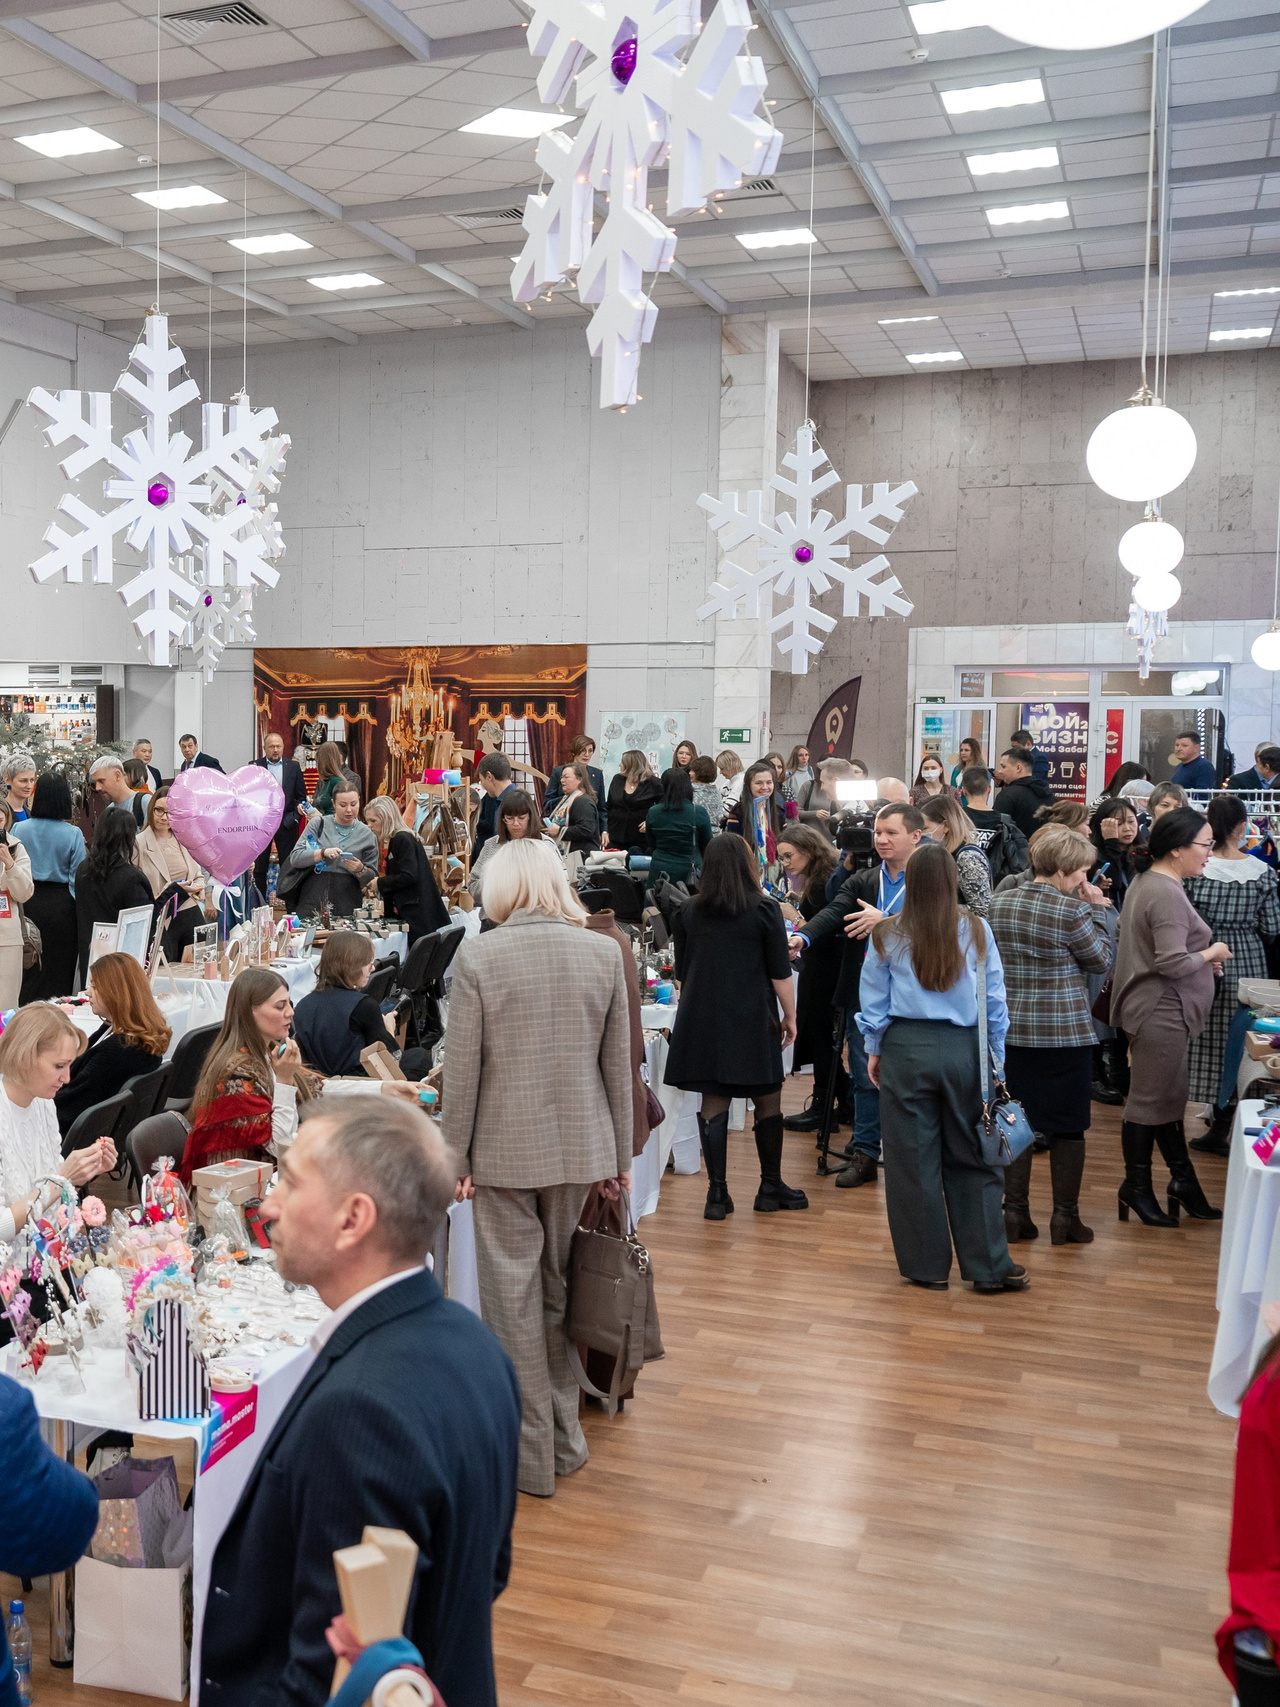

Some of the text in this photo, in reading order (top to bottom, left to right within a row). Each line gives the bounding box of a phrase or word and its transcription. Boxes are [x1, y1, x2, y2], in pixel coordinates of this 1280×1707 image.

[1029, 712, 1080, 730] МОЙ
[1029, 730, 1119, 745] БИЗНС
[217, 825, 259, 834] ENDORPHIN
